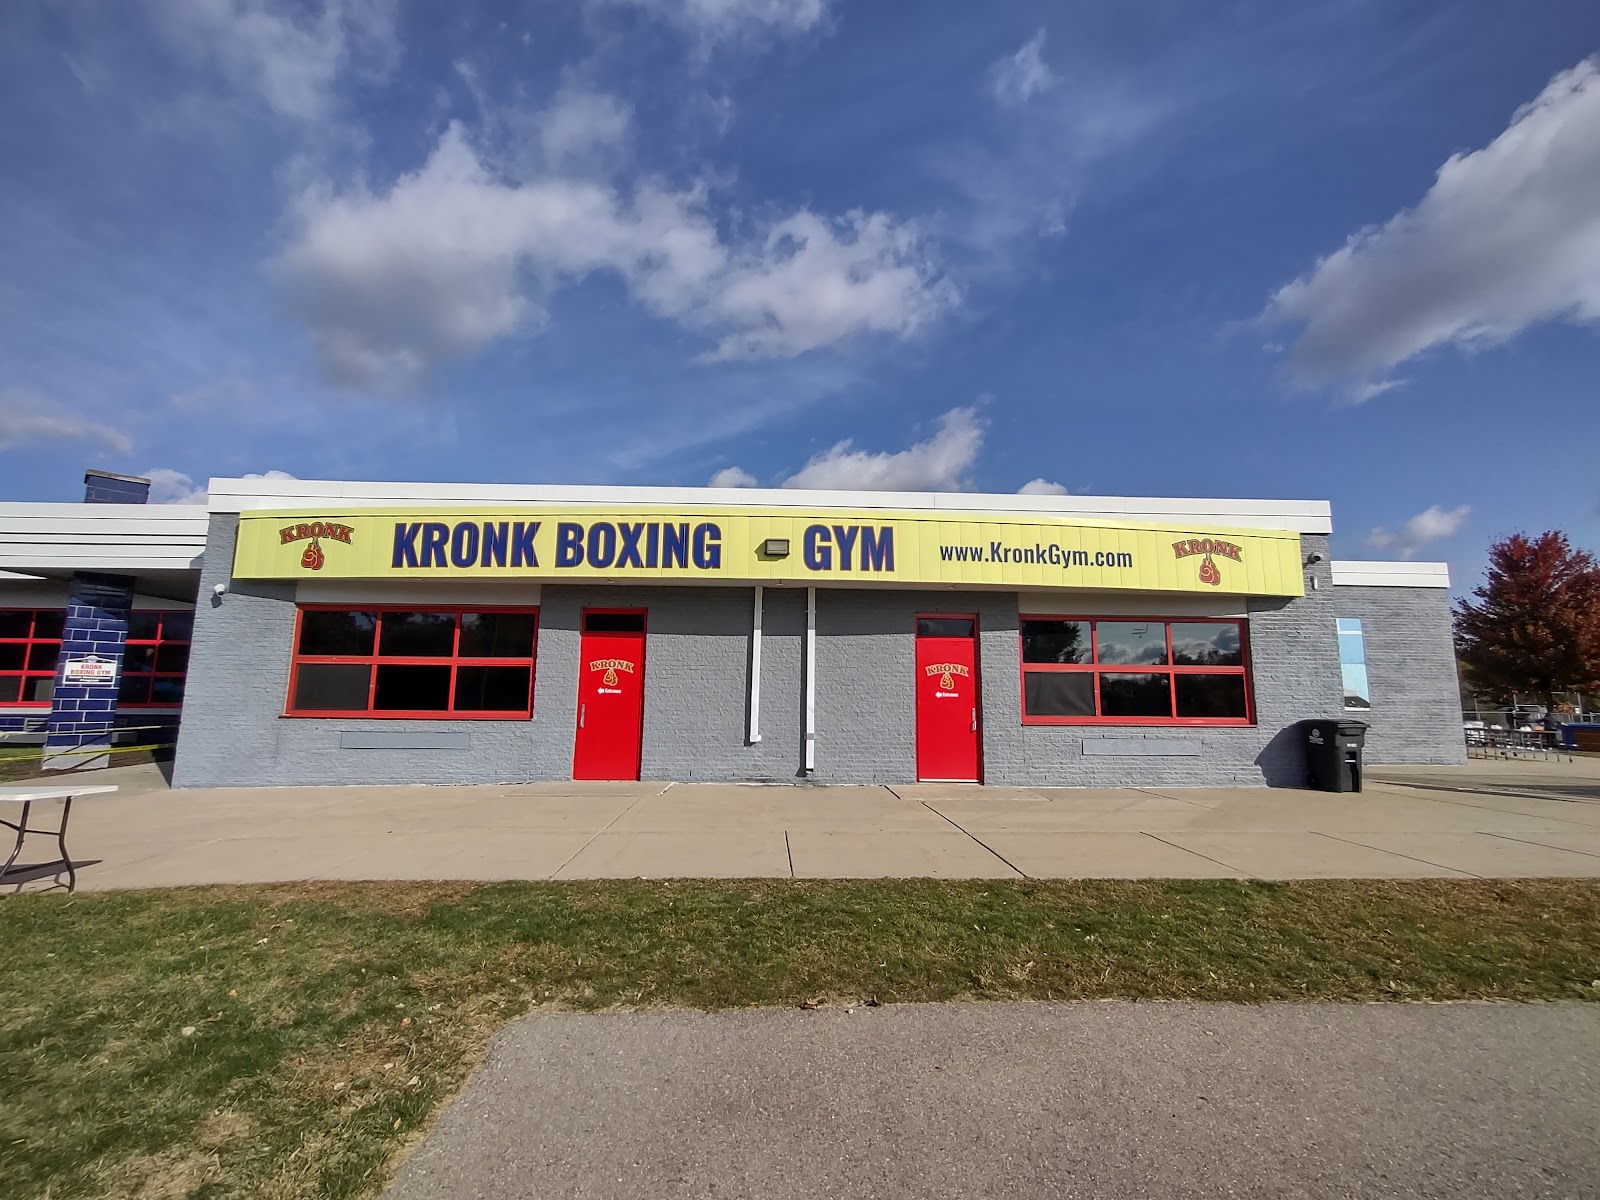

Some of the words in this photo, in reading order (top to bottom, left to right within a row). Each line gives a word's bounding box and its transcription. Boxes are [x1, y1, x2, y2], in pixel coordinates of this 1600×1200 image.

[279, 521, 354, 545] KRONK
[391, 521, 542, 568] KRONK
[554, 521, 722, 569] BOXING
[803, 524, 895, 572] GYM
[939, 541, 1133, 569] www.KronkGym.com
[1171, 538, 1243, 563] KRONK
[589, 659, 634, 673] KRONK
[925, 663, 969, 677] KRONK
